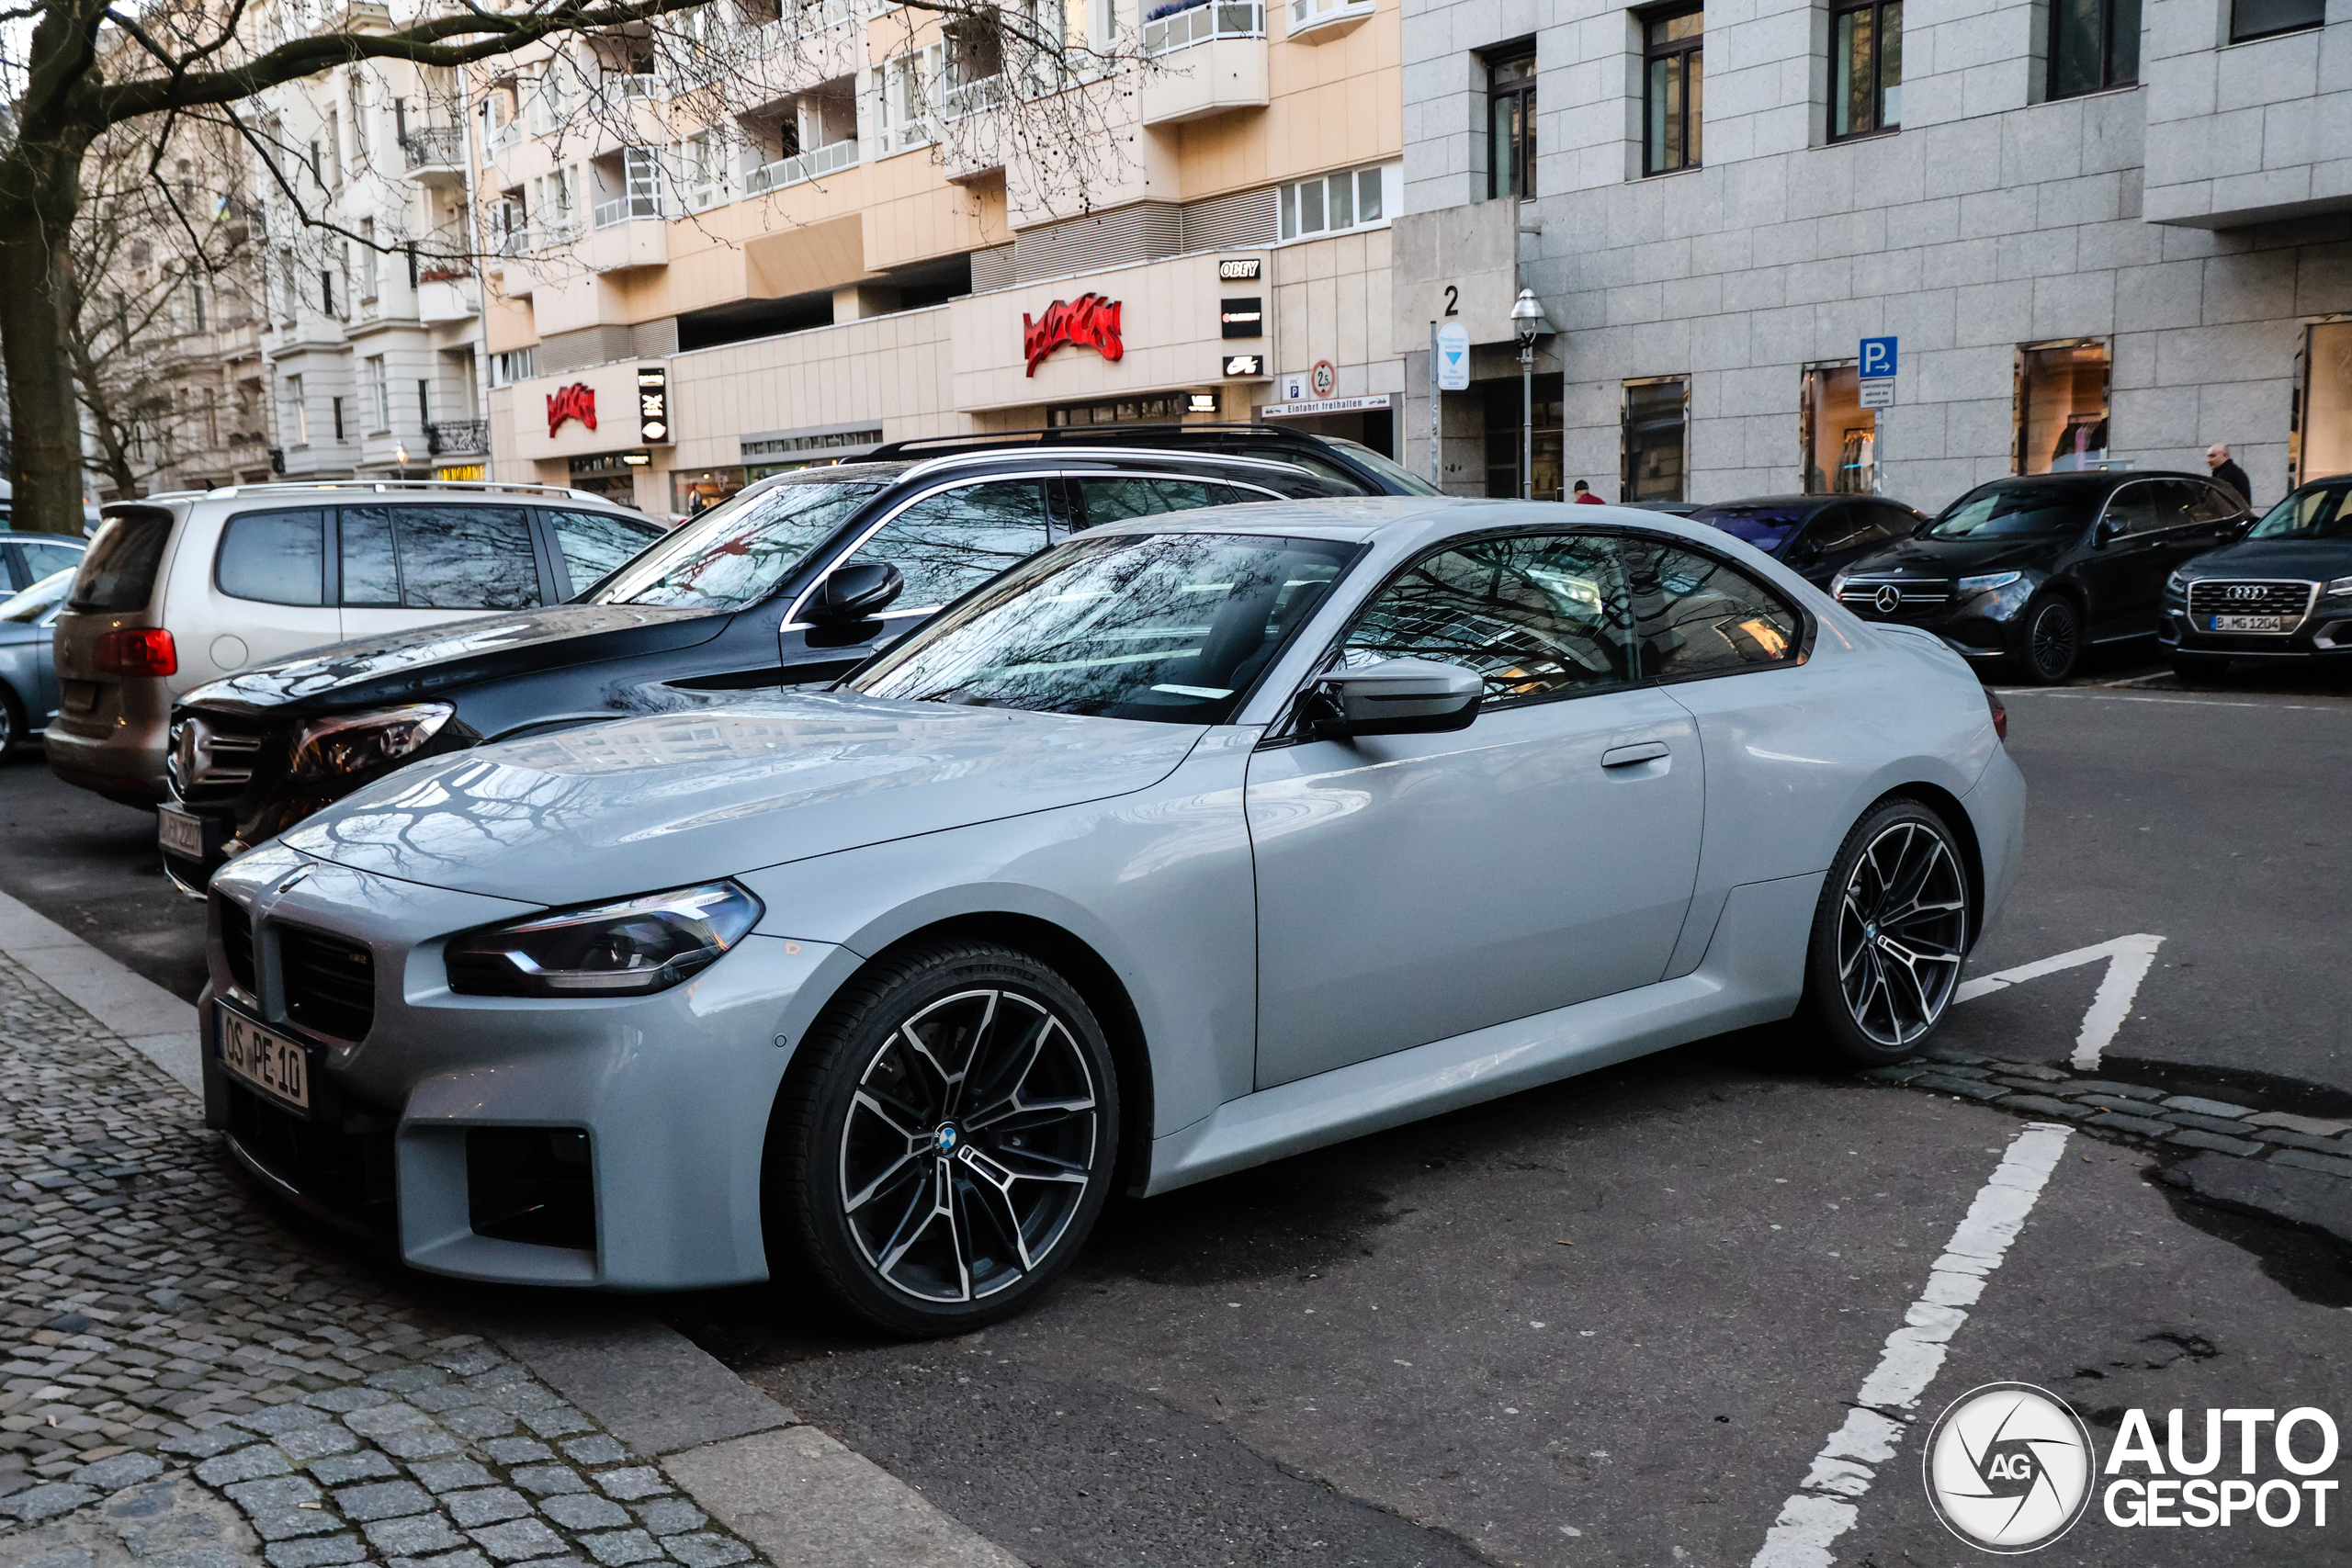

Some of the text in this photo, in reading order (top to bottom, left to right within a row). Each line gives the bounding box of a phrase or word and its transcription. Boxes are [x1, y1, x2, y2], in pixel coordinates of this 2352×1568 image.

[1220, 260, 1260, 277] OBEY
[1444, 285, 1458, 317] 2
[1865, 342, 1886, 373] P
[1292, 387, 1298, 398] P
[1287, 400, 1363, 413] Einfahrt freihalten
[2217, 616, 2278, 629] B MG 1204
[226, 1015, 301, 1099] OS PE 10
